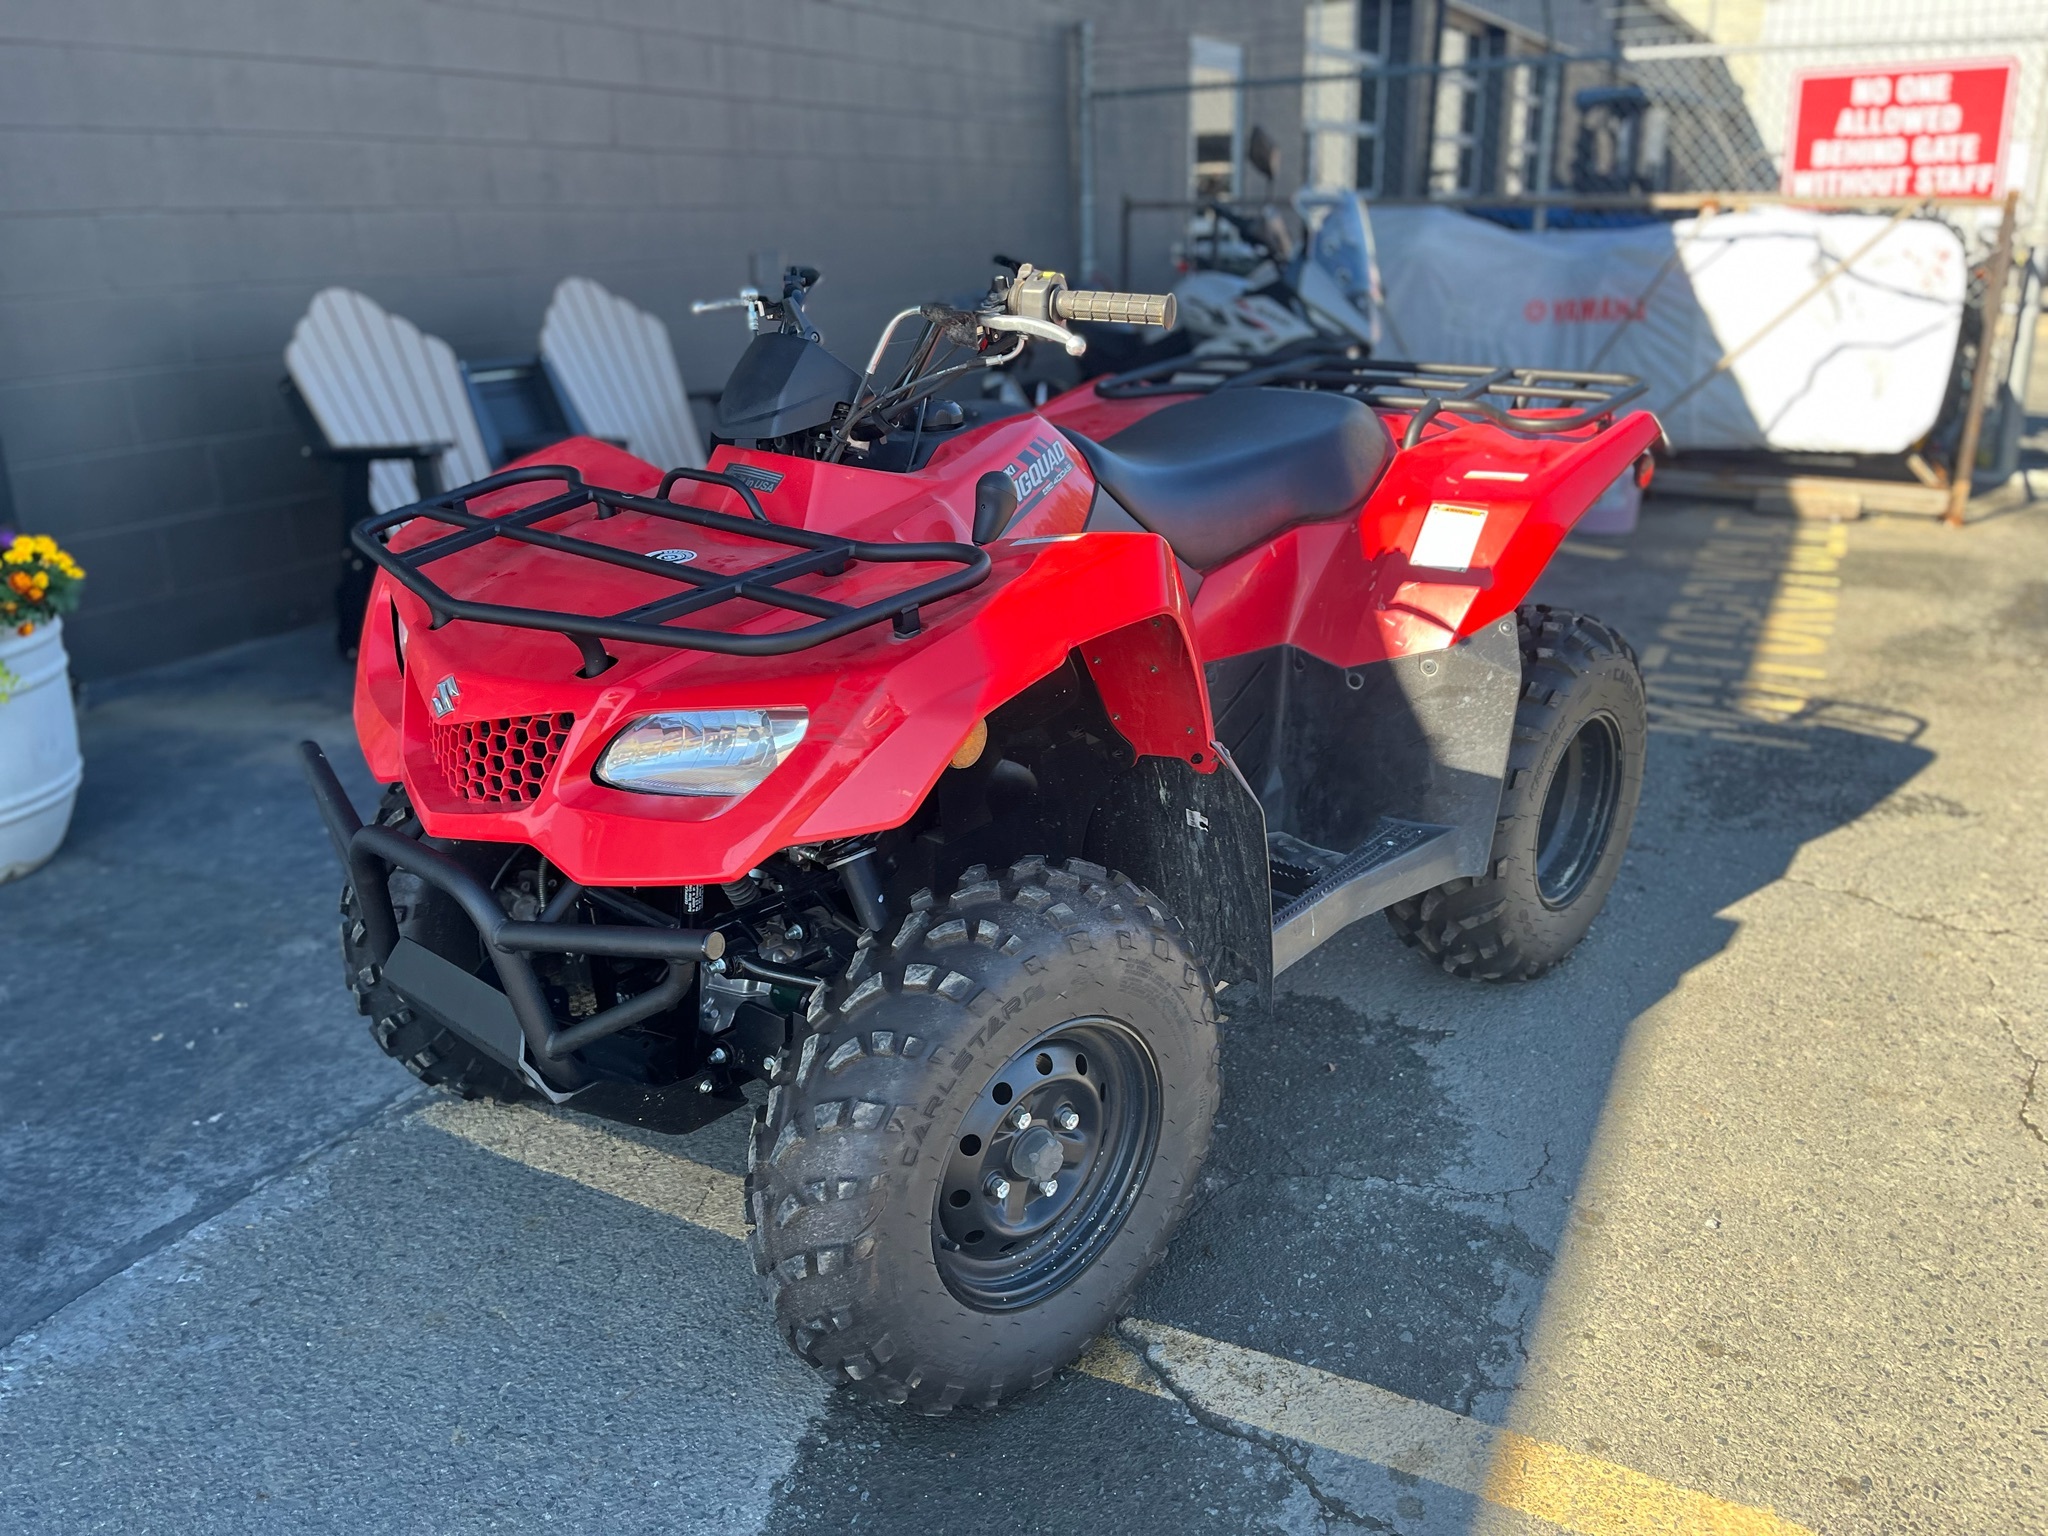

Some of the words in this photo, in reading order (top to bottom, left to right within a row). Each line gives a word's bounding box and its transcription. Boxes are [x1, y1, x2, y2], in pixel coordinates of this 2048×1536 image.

[1851, 76, 1893, 105] NO
[1896, 73, 1953, 104] ONE
[1834, 103, 1963, 137] ALLOWED
[1810, 137, 1908, 168] BEHIND
[1910, 132, 1981, 165] GATE
[1794, 166, 1913, 197] WITHOUT
[1914, 163, 1995, 195] STAFF
[754, 480, 775, 493] USA
